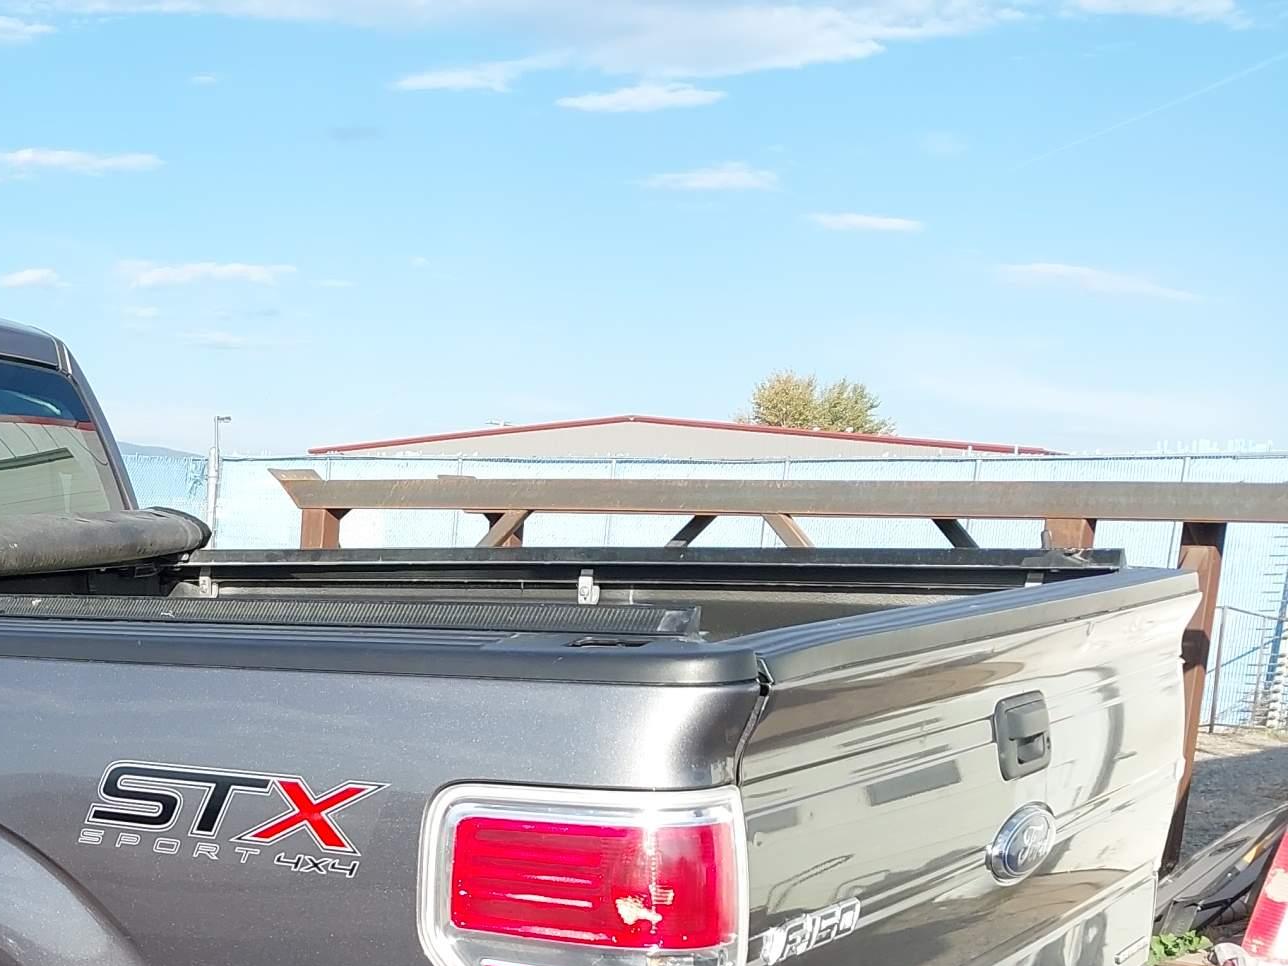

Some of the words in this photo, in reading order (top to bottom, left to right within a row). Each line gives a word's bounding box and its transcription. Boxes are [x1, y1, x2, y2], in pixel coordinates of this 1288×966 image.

[84, 760, 392, 856] STX
[78, 829, 261, 863] SPORT
[1016, 823, 1047, 866] Ford
